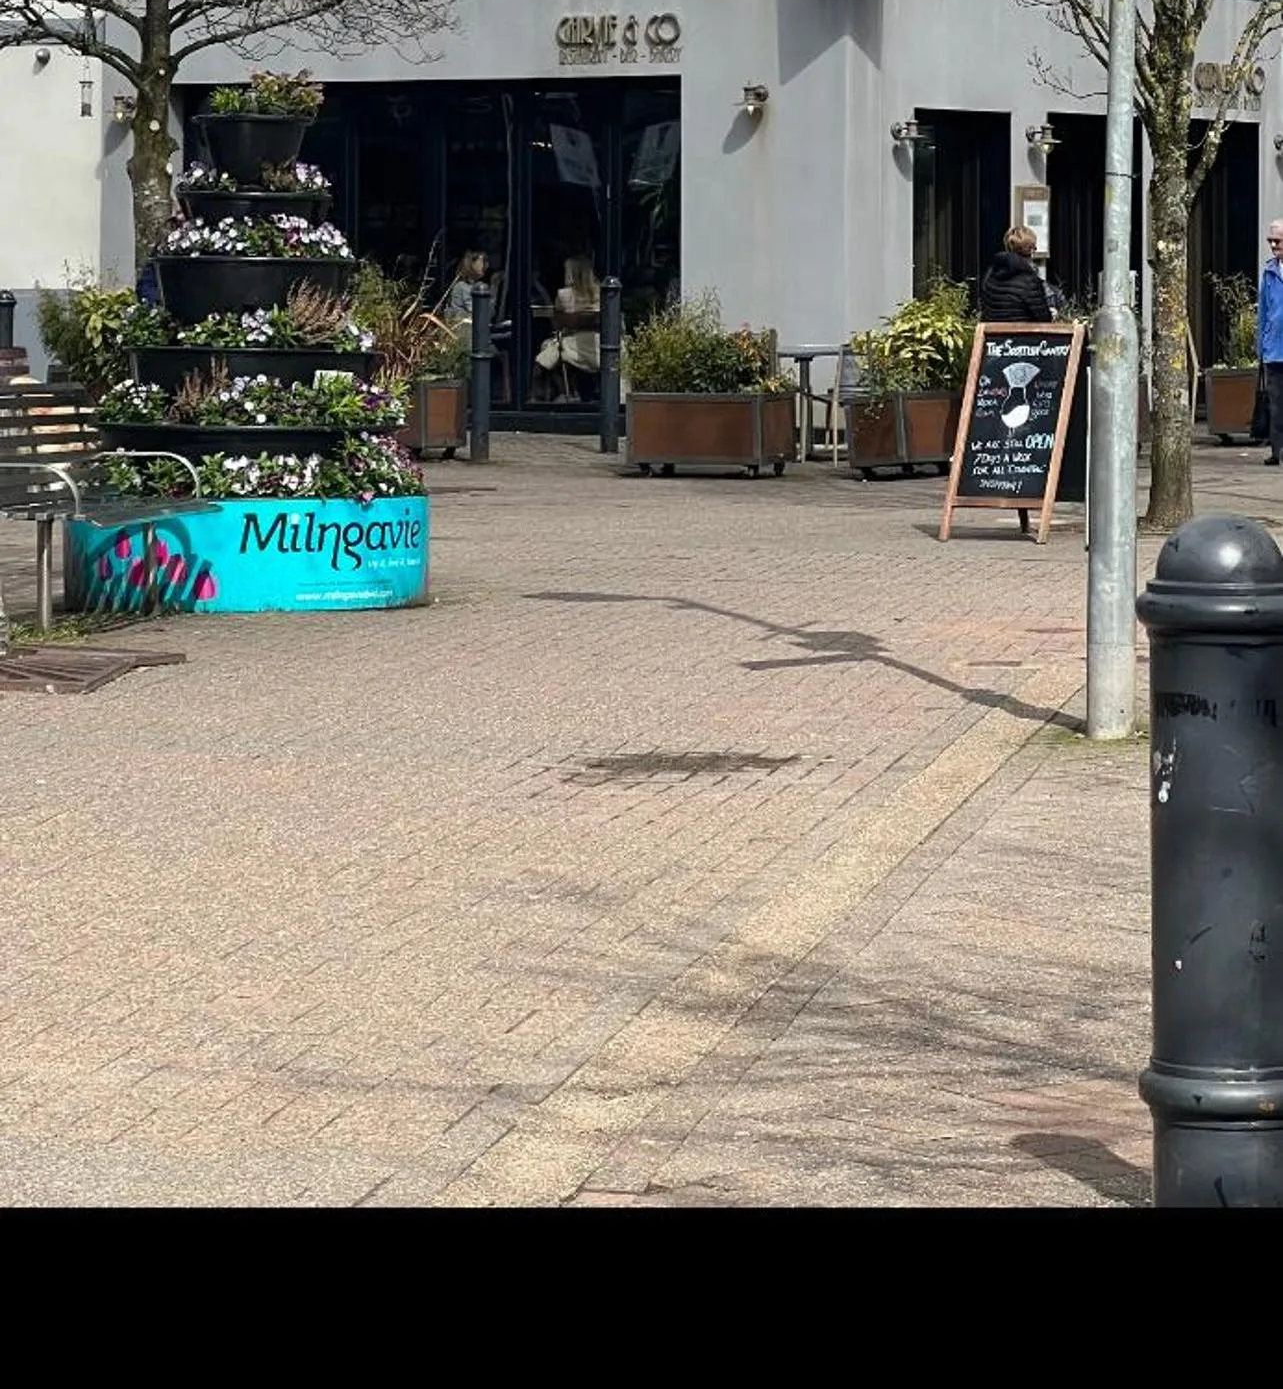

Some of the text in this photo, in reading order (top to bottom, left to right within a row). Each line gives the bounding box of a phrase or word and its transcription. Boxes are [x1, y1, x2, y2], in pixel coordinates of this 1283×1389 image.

[644, 12, 681, 47] CO
[986, 341, 1004, 357] THE
[1025, 432, 1055, 449] OPEN
[239, 508, 422, 572] Milngavie
